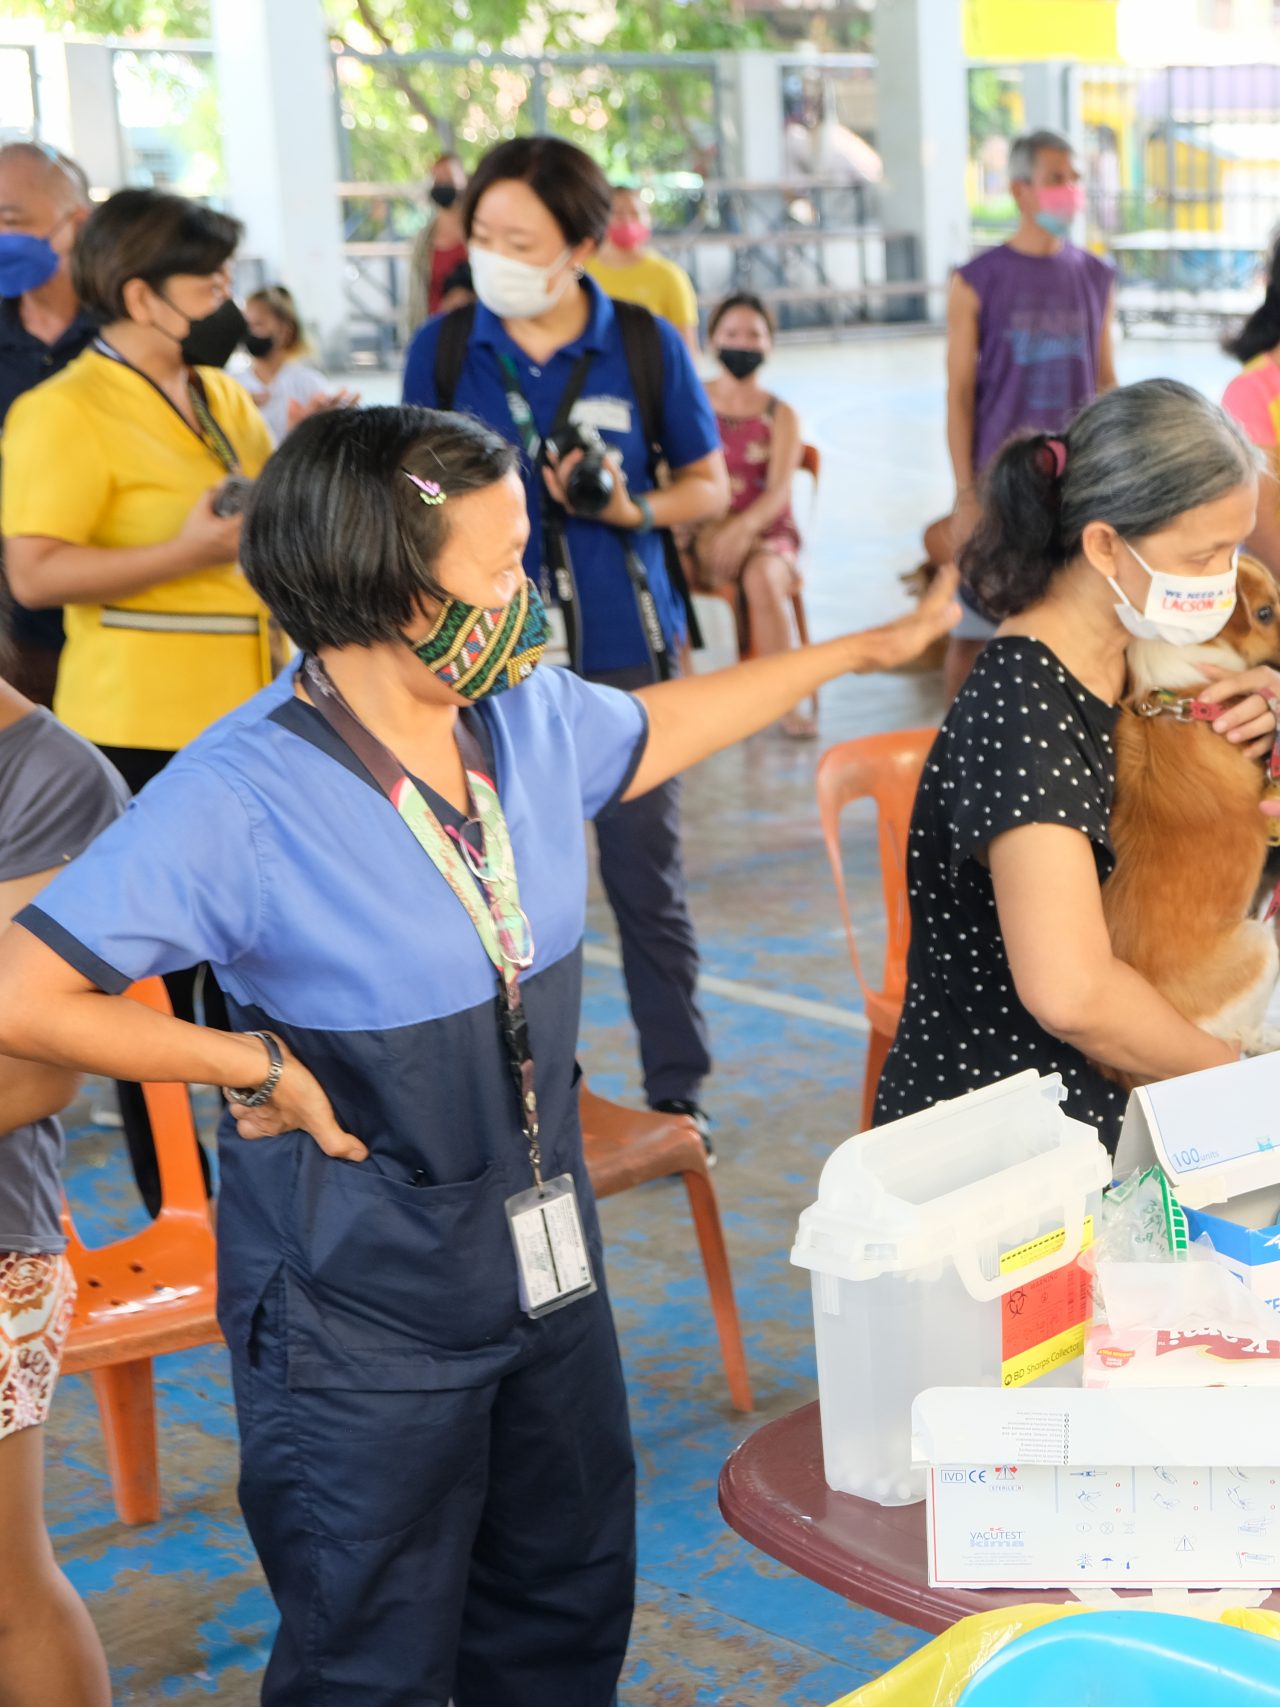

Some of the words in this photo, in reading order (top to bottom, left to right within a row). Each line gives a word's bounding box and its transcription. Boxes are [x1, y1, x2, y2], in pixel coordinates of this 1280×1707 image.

[1165, 589, 1182, 599] WE
[1187, 591, 1215, 599] NEED
[1172, 1148, 1200, 1168] 100
[1201, 1151, 1220, 1162] units
[1014, 1368, 1025, 1381] BD
[1026, 1358, 1050, 1375] Sharps
[1051, 1342, 1080, 1362] Collector
[944, 1472, 964, 1482] IVD
[970, 1531, 1023, 1540] VACUTEST
